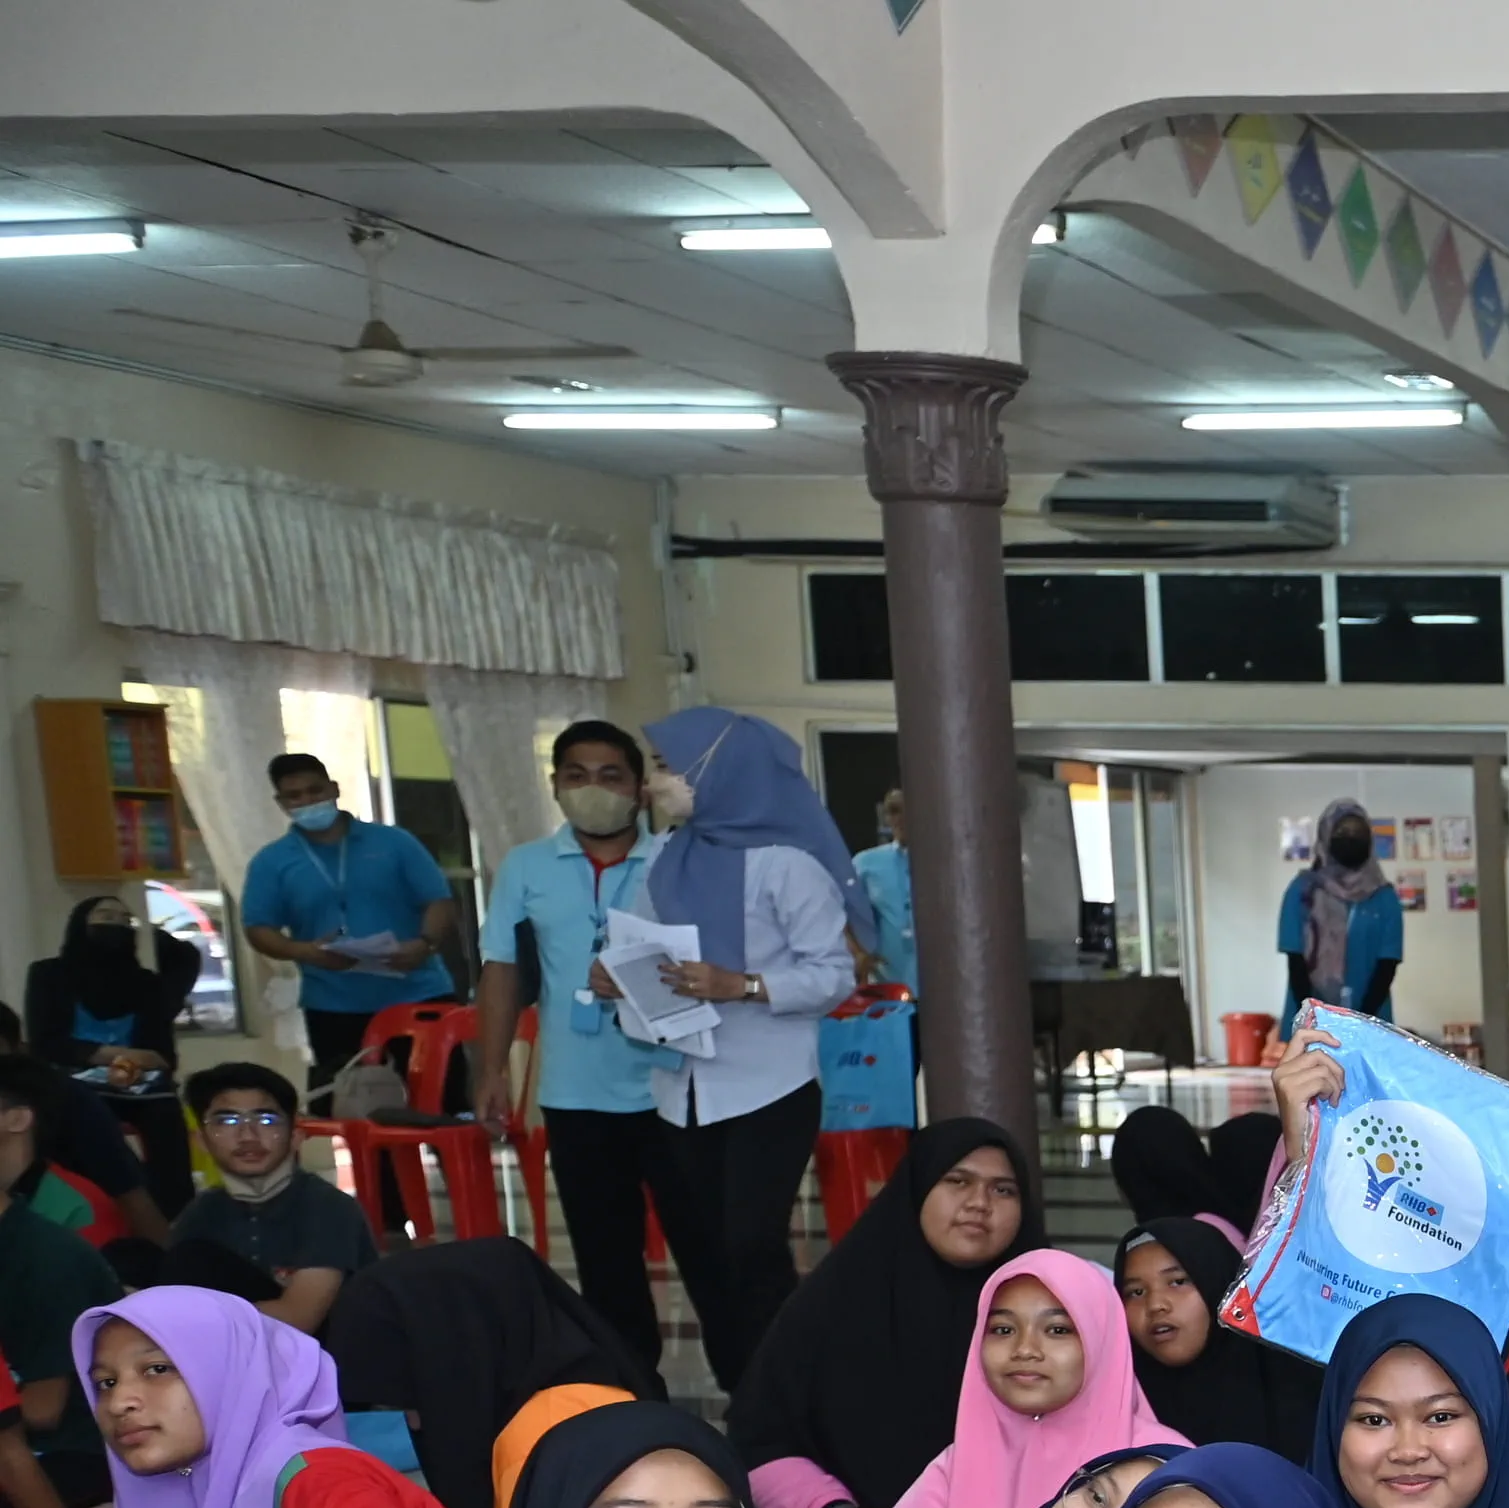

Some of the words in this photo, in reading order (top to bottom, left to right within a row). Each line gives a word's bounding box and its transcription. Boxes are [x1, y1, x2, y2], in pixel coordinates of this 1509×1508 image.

[1400, 1192, 1427, 1214] RHB
[1387, 1205, 1463, 1252] Foundation
[1296, 1250, 1338, 1286] Nurturing
[1342, 1273, 1382, 1299] Future
